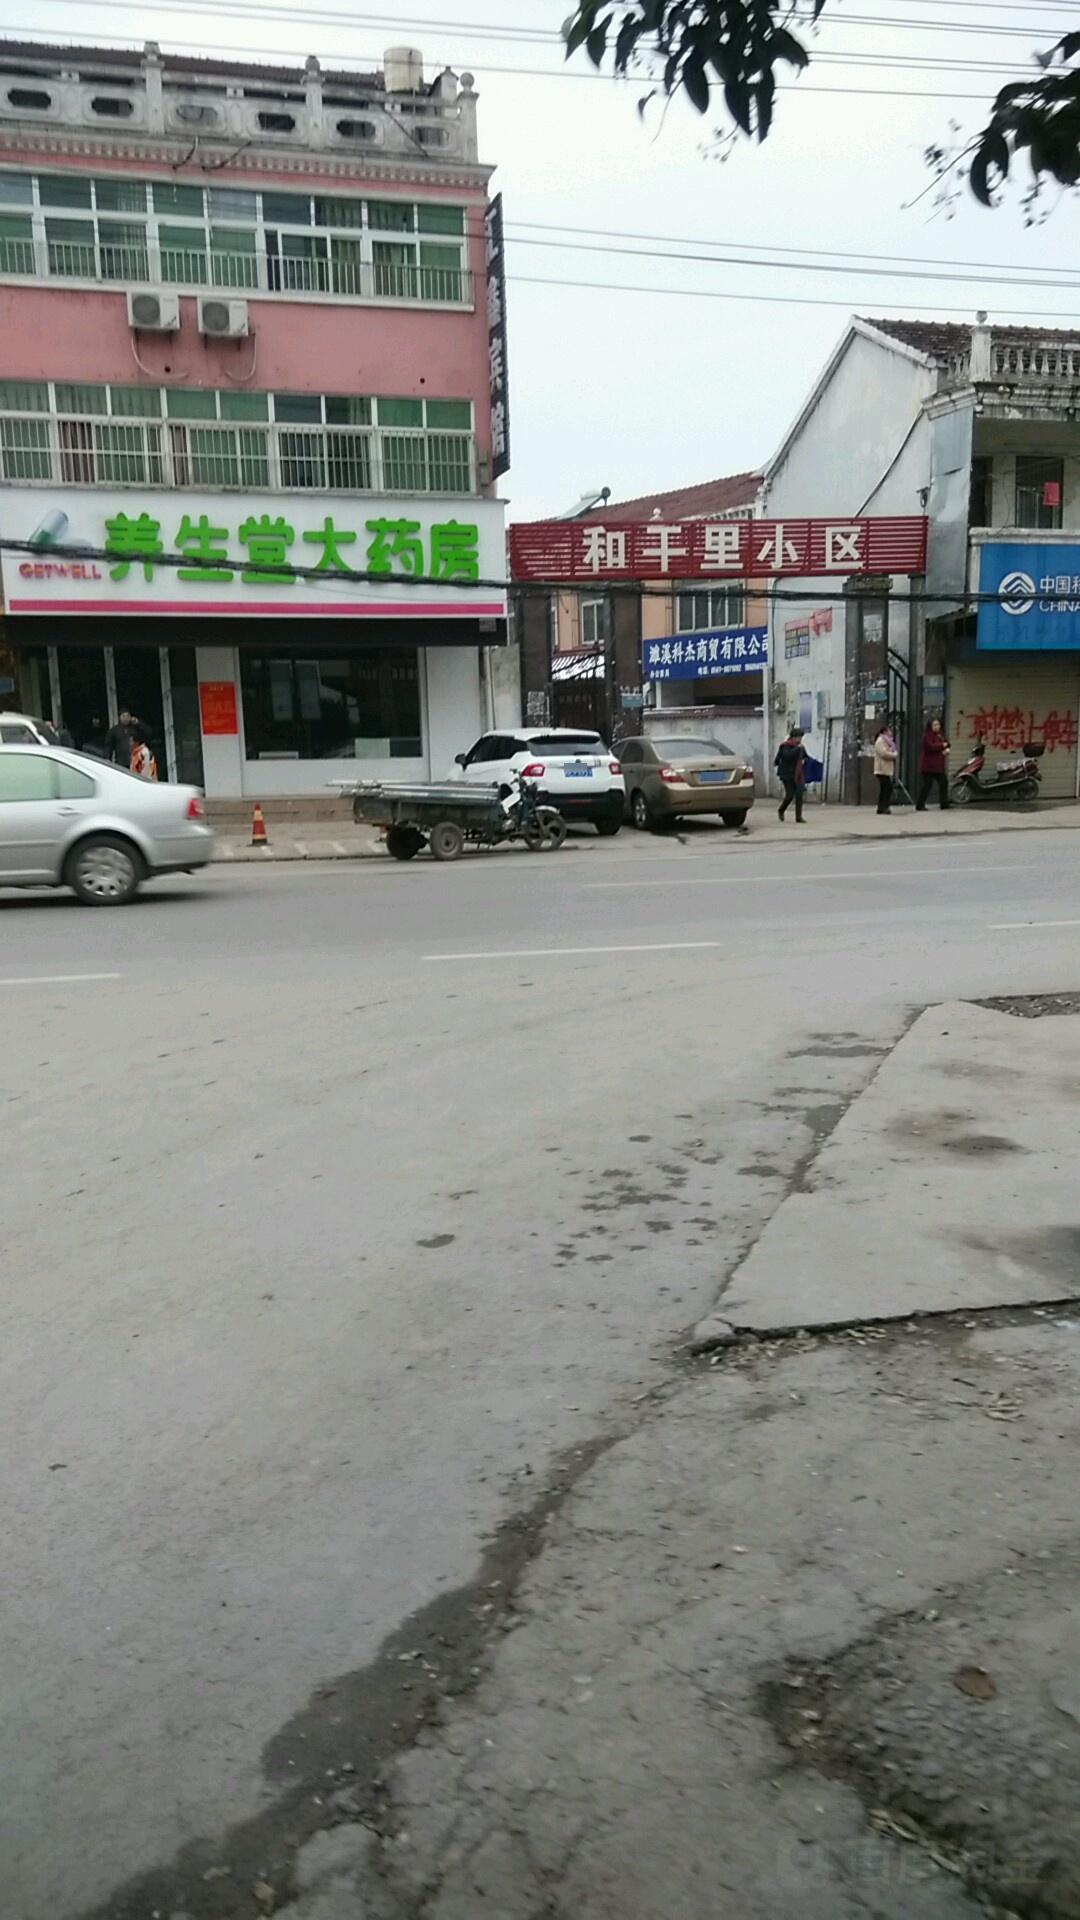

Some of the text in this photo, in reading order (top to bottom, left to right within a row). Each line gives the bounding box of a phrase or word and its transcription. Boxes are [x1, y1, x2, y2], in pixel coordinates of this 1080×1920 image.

[104, 512, 480, 584] 养生堂大药房
[18, 562, 102, 579] GETWELL
